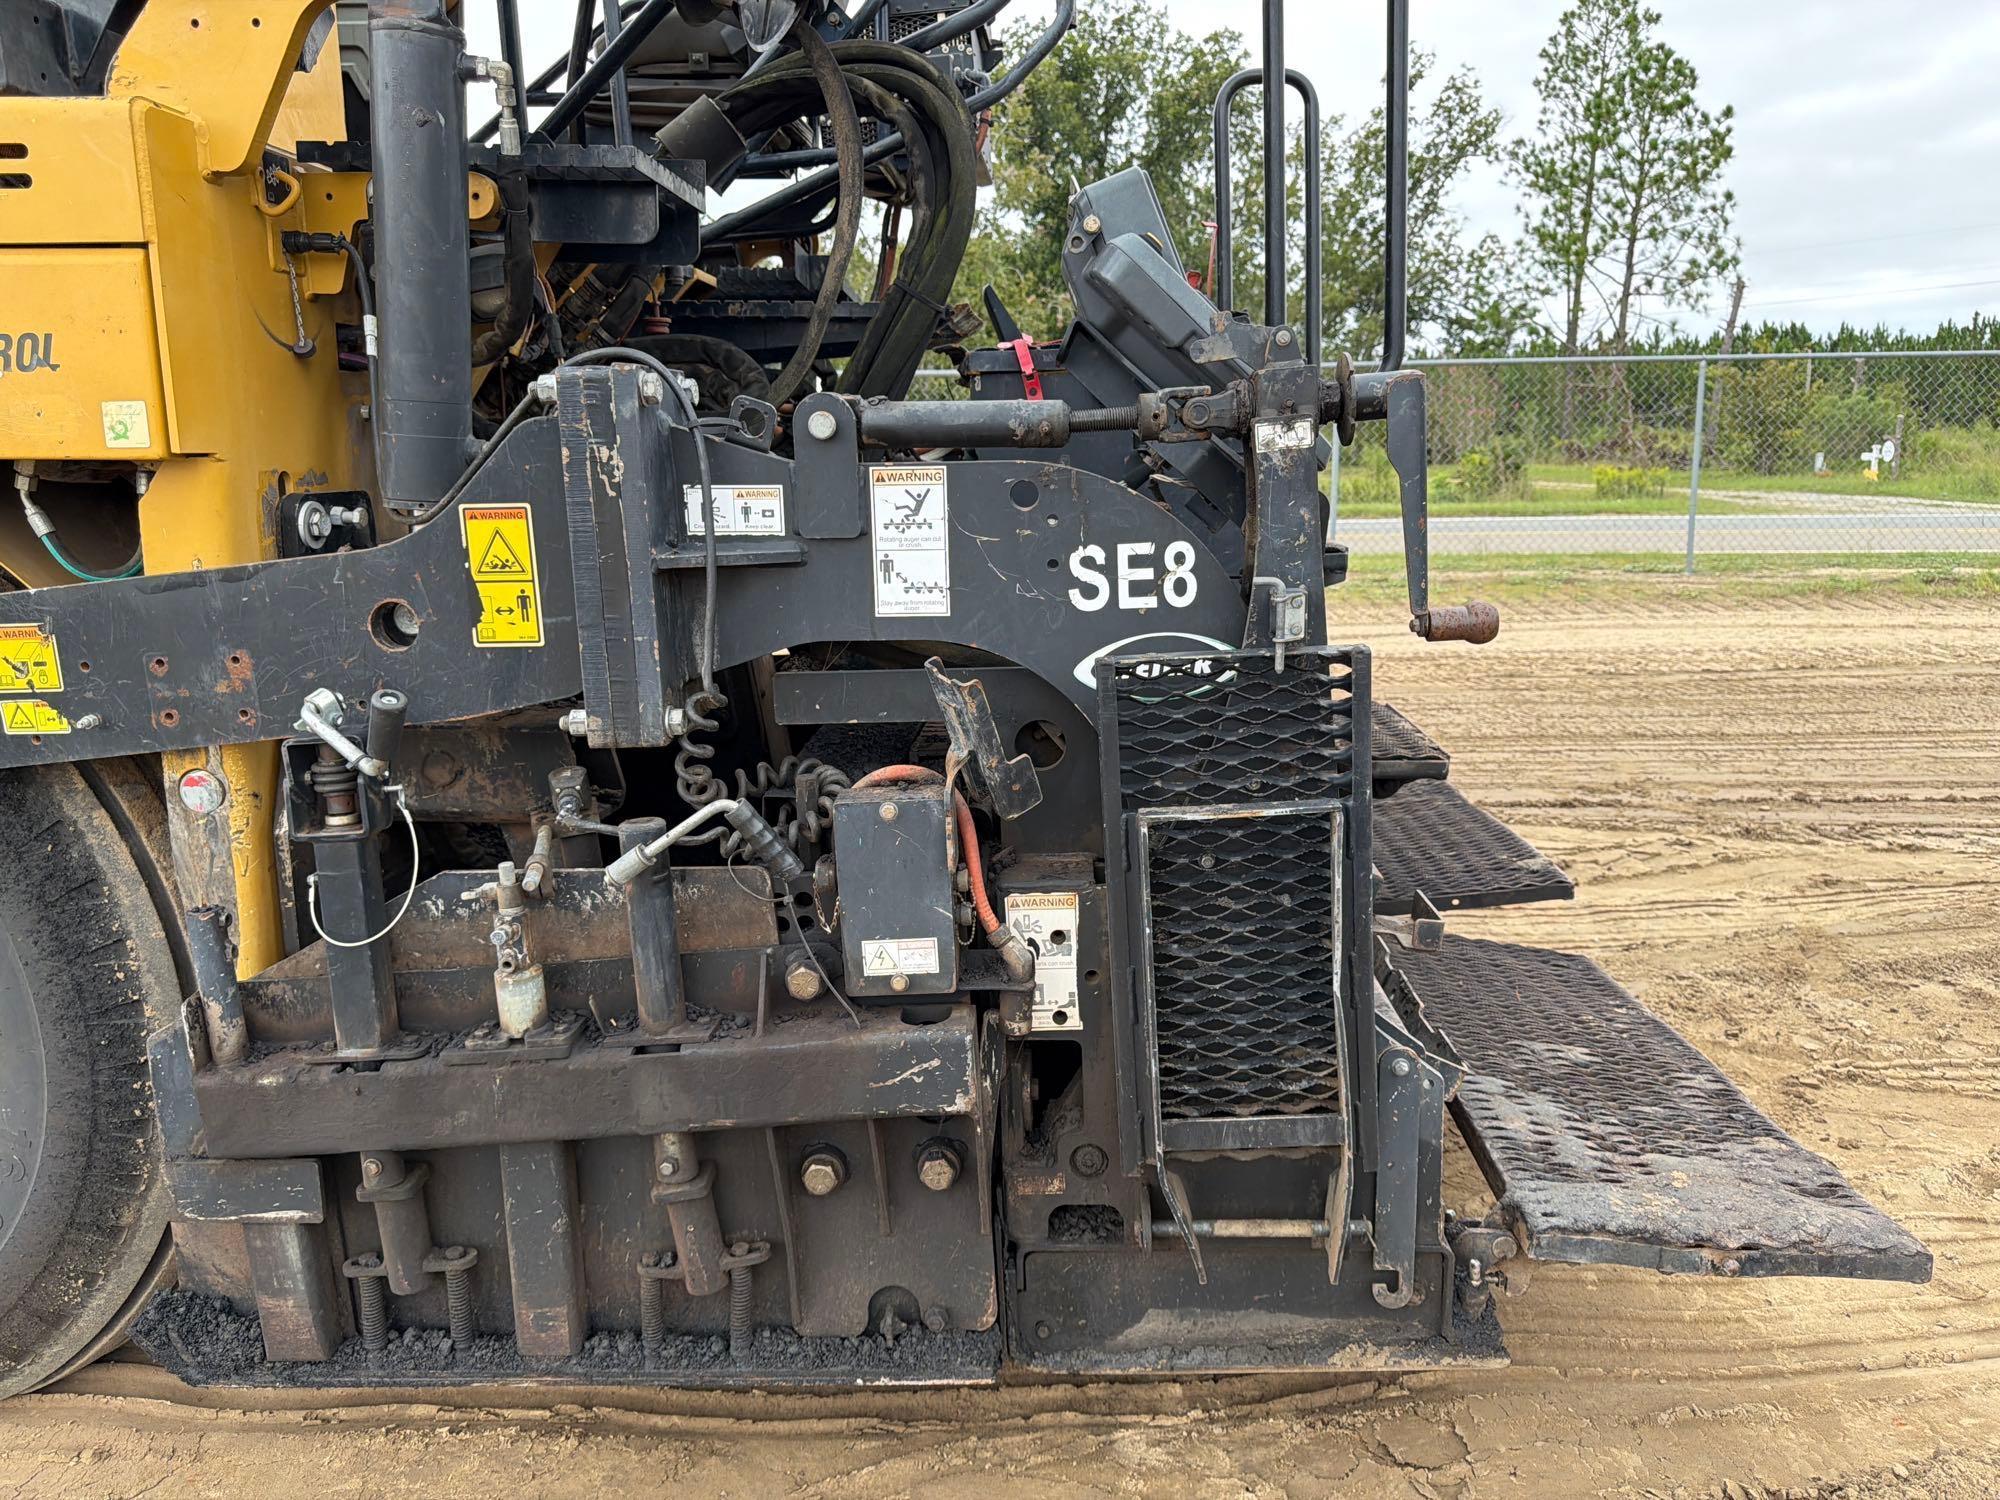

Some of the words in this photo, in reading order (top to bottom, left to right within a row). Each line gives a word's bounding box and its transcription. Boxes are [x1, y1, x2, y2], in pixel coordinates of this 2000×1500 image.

[885, 471, 942, 482] WARNING
[745, 490, 778, 498] WARNING
[480, 511, 523, 520] WARNING
[879, 536, 902, 544] Rotating
[904, 536, 919, 544] auger
[1068, 540, 1198, 612] SE8
[4, 629, 42, 639] WARNIN
[1021, 897, 1074, 907] WARNING
